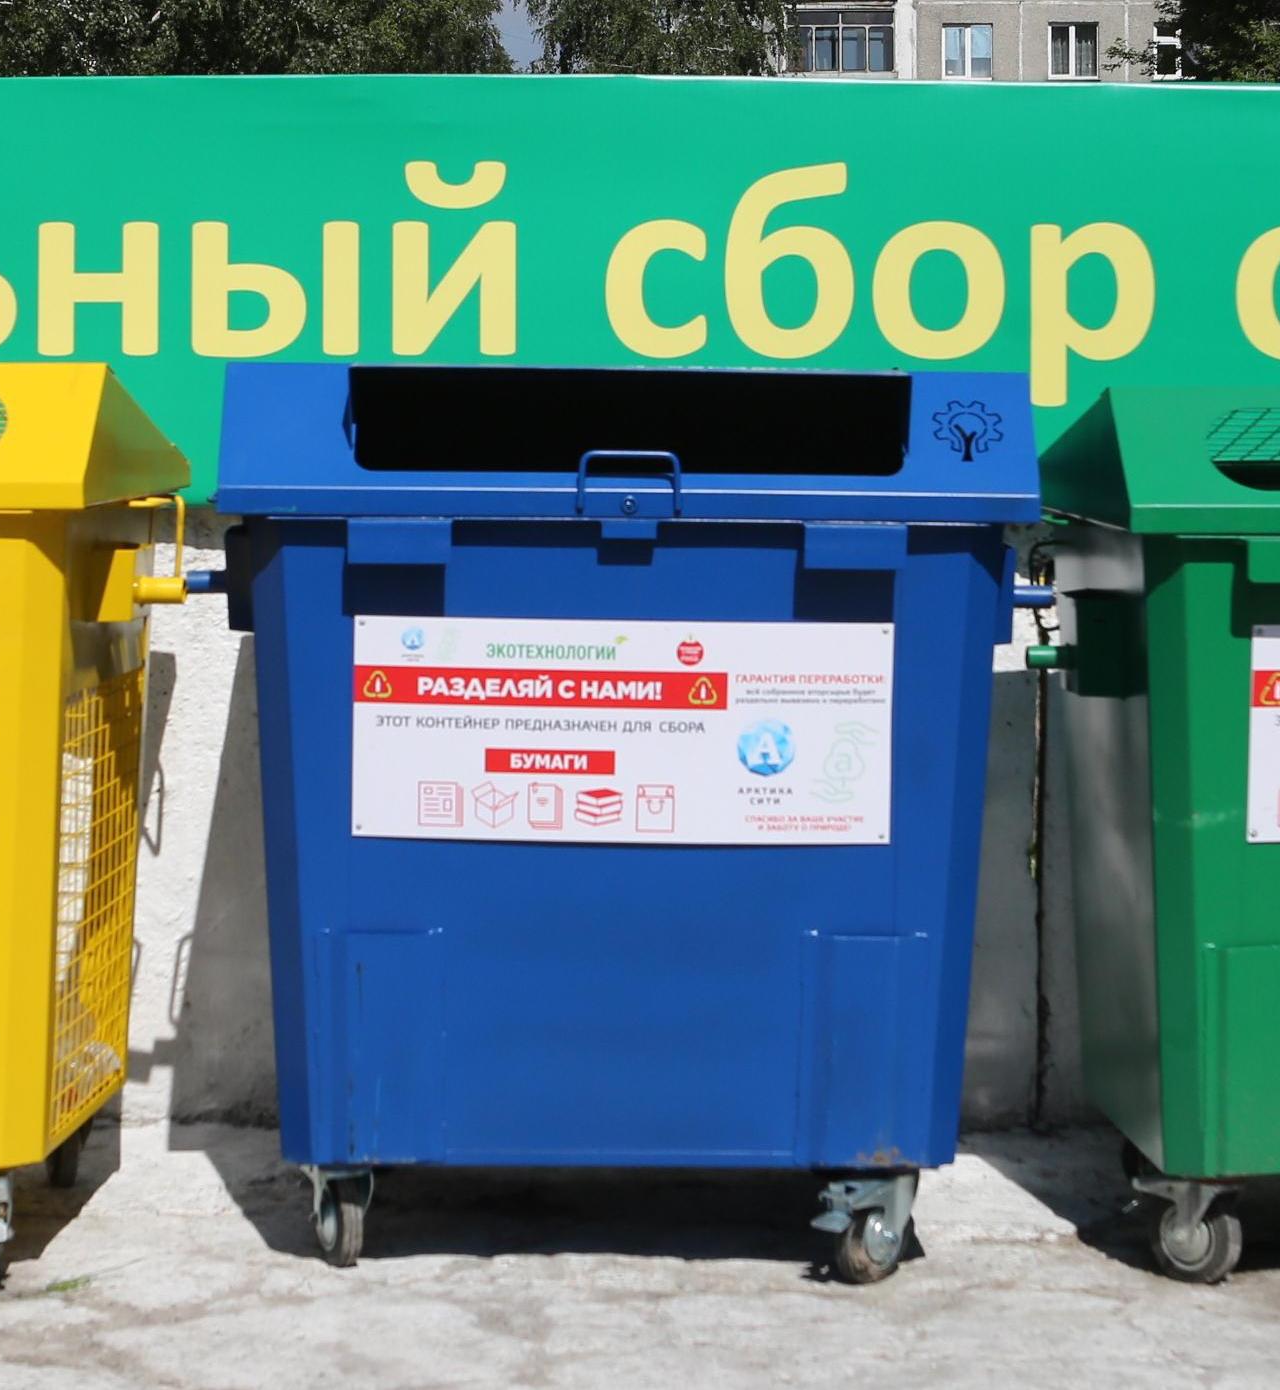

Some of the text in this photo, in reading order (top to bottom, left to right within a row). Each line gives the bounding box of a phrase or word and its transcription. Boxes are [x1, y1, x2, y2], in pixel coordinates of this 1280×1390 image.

[604, 162, 1156, 407] сбор
[486, 643, 616, 661] ЭКОТЕХНОЛОГИИ
[417, 674, 663, 702] РАЗДЕЛЯЙ С НАМИ!
[735, 674, 796, 684] ГАРАНТИЯ
[375, 714, 705, 734] ЭТОТ КОНТЕЙНЕР ПРЕДНАЗНАЧЕН ДЛЯ СБОРА
[510, 753, 588, 770] БУМАГИ
